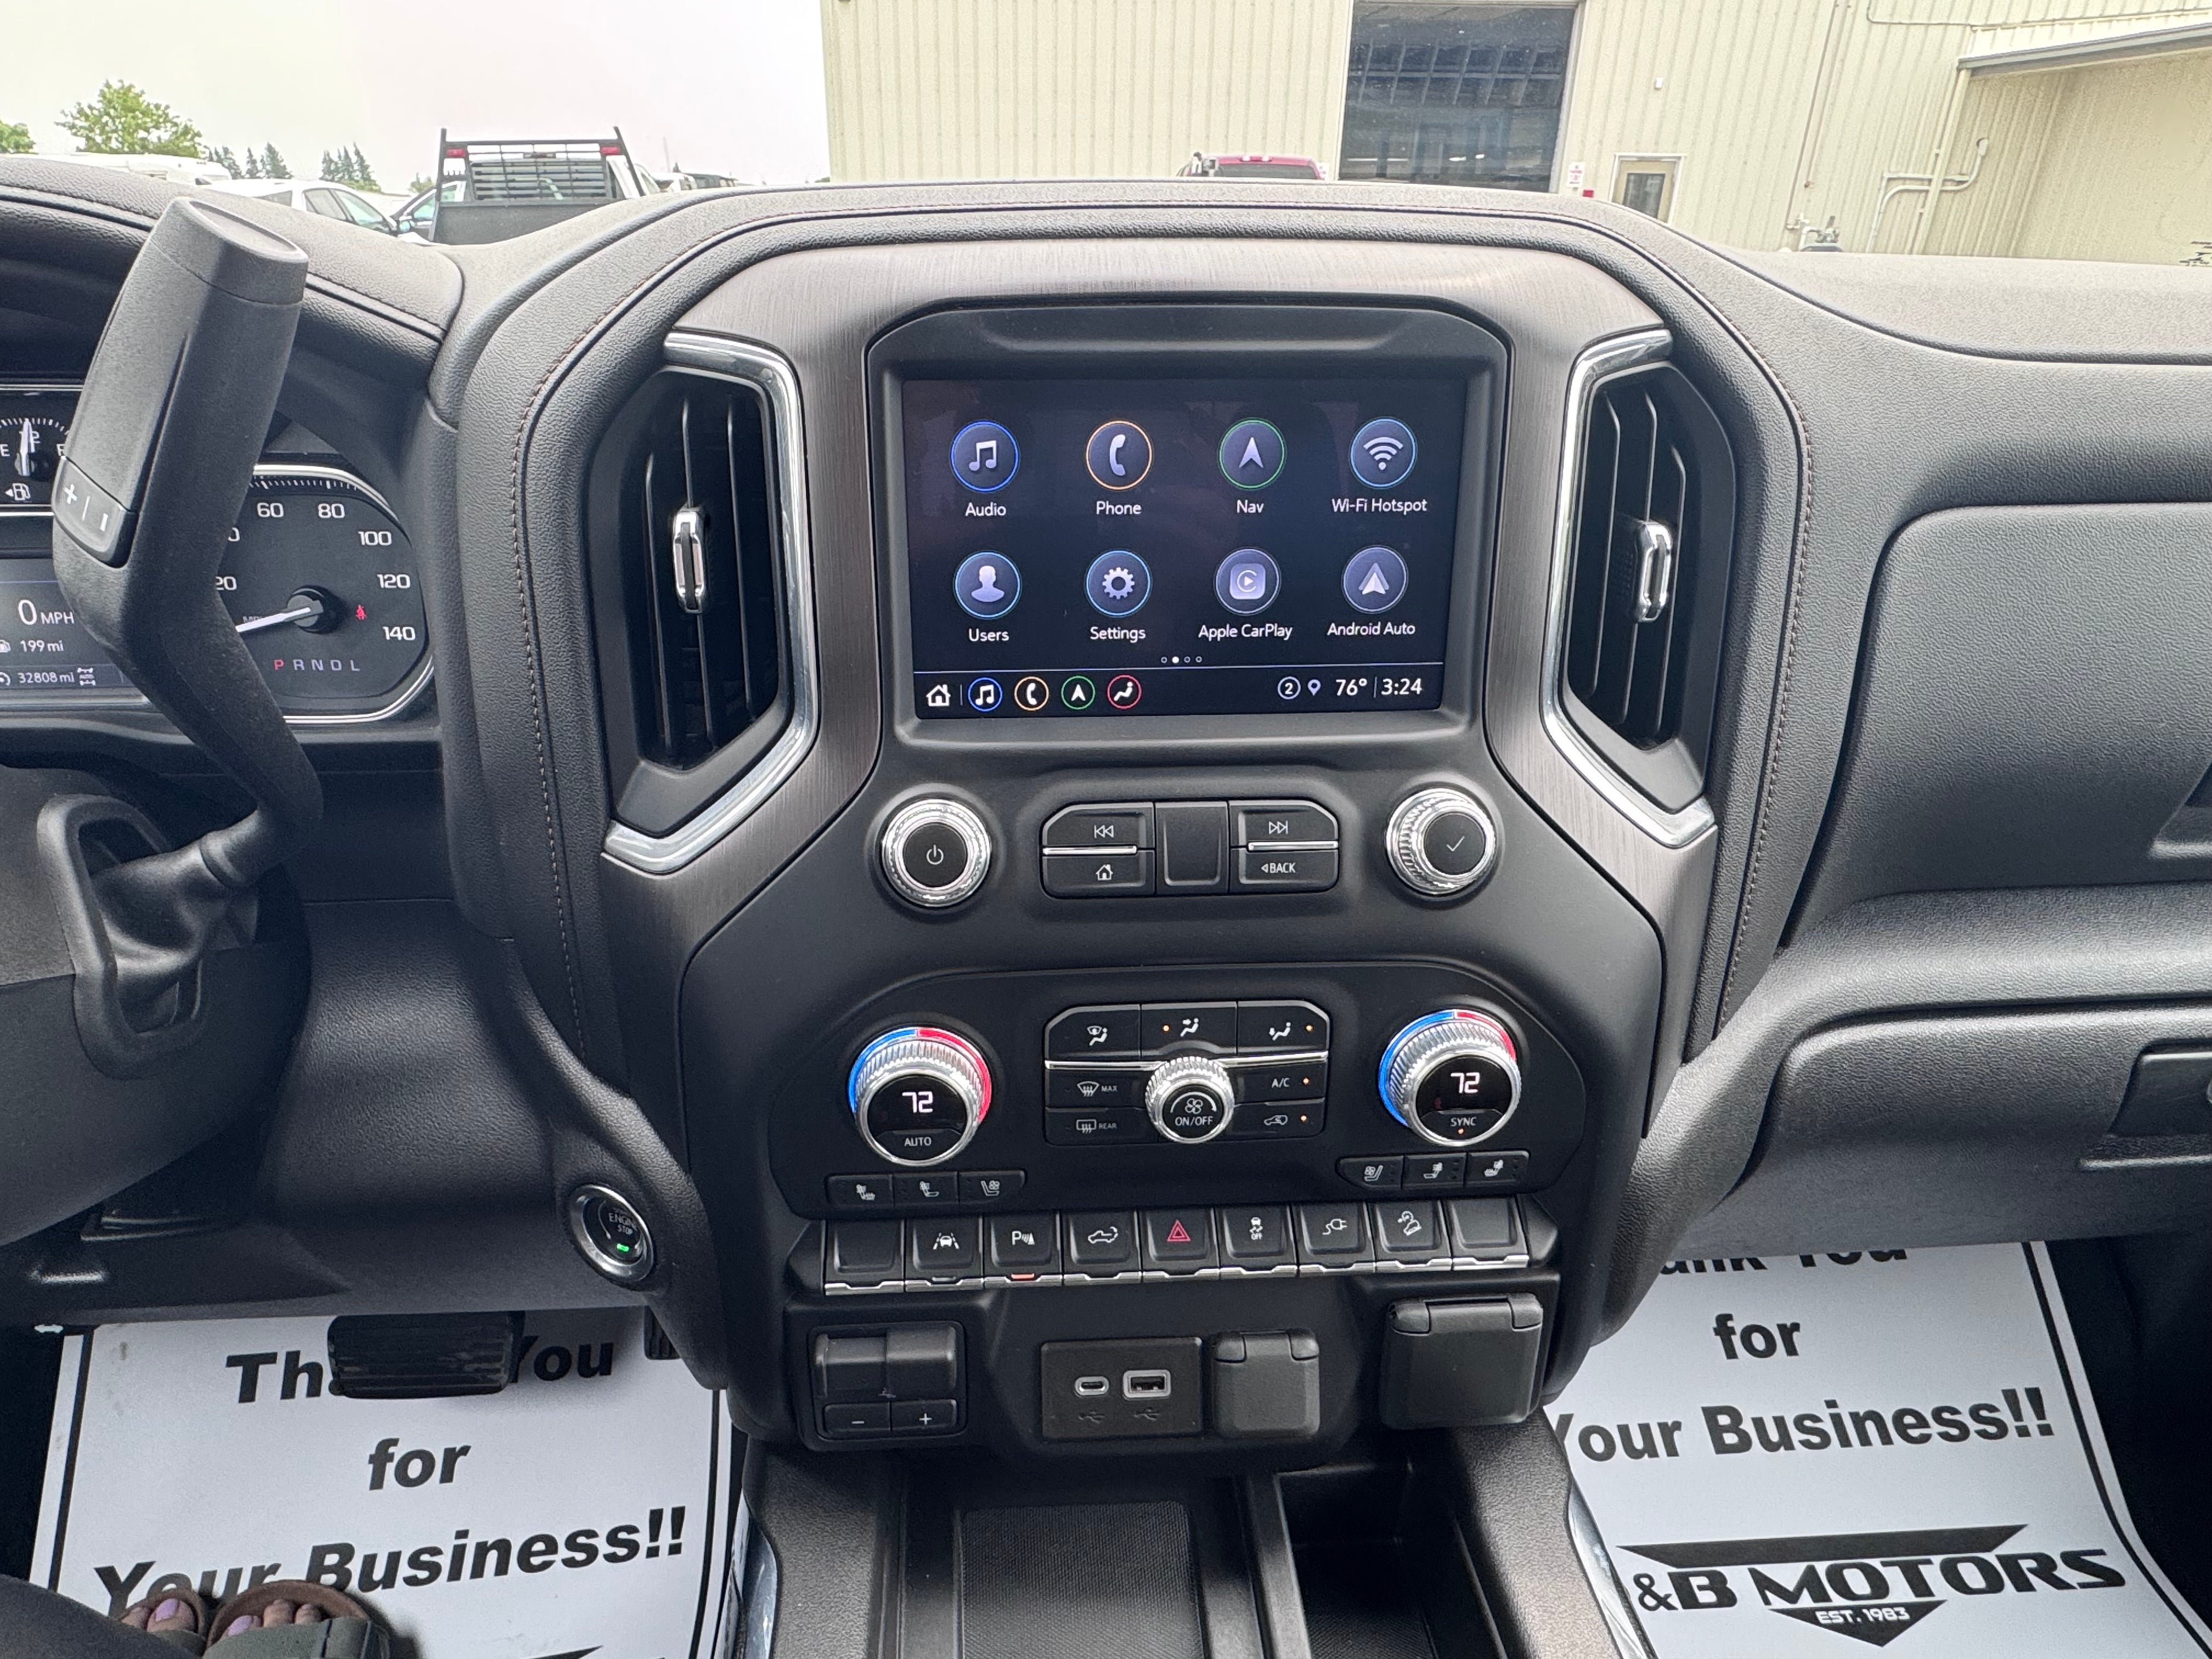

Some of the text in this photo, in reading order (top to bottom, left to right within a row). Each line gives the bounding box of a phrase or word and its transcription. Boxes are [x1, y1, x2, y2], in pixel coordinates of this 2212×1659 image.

[256, 502, 285, 518] 60
[318, 503, 346, 518] 80
[965, 501, 1007, 517] Audio
[1096, 500, 1142, 515] Phone
[1236, 500, 1265, 514] Nav
[1331, 498, 1427, 515] Wi-Fi Hotspot
[358, 531, 393, 546] 100
[376, 574, 411, 589] 120
[18, 599, 75, 625] 0 MPH
[382, 626, 416, 641] 140
[968, 628, 1010, 642] Users
[1090, 626, 1147, 644] Settings
[1198, 623, 1293, 641] Apple CarPlay
[1327, 622, 1417, 636] Android Auto
[20, 639, 64, 653] 199 mi
[274, 659, 360, 672] P R N D L
[18, 672, 58, 684] 32808
[1335, 678, 1368, 696] 76°
[1381, 678, 1423, 696] 3:24
[1269, 862, 1296, 873] BACK
[1101, 1084, 1118, 1092] MAX
[1271, 1077, 1290, 1088] A/C
[1450, 1071, 1481, 1094] 72
[901, 1091, 934, 1114] 72
[1174, 1115, 1214, 1126] ON/OFF
[1449, 1116, 1477, 1127] SYNC
[904, 1136, 932, 1147] AUTO
[1713, 1313, 1801, 1360] for
[1701, 1386, 2055, 1455] Business!!
[368, 1437, 472, 1491] for
[305, 1505, 686, 1593] Business!!
[1747, 1548, 2126, 1606] MOTORS
[1815, 1606, 1910, 1624] EST. 1983
